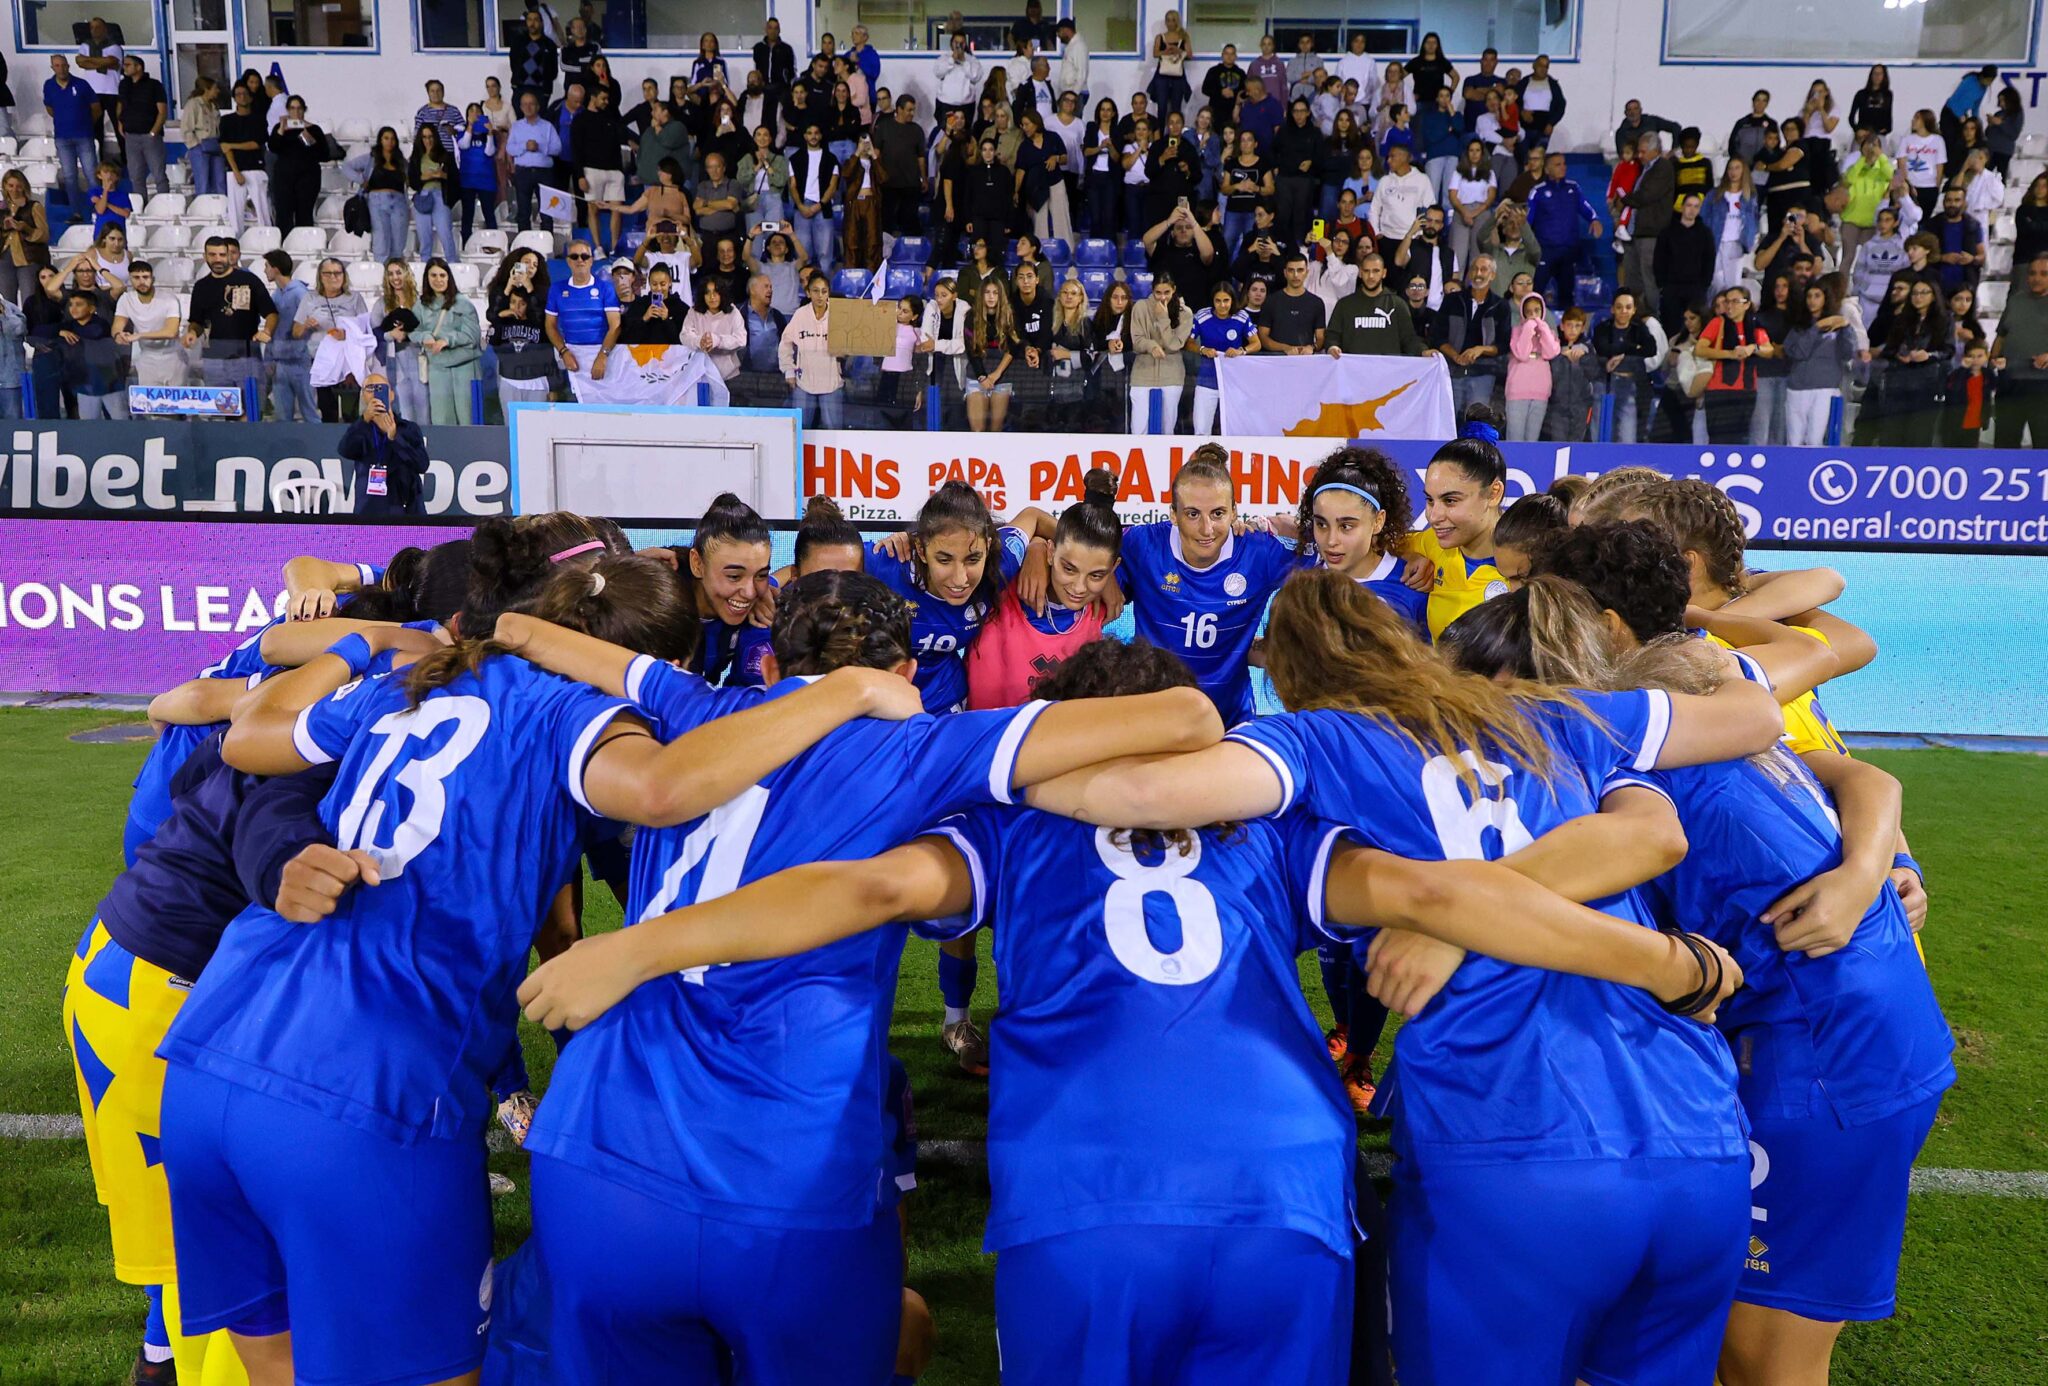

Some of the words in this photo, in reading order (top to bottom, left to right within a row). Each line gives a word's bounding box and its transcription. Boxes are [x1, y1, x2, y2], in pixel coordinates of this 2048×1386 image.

[1354, 316, 1387, 329] PUMA
[146, 387, 212, 402] ΚΑΡΠΑΣΙΑ
[0, 430, 178, 510] ibet
[803, 443, 901, 500] HNS
[928, 457, 1006, 489] PAPA
[1161, 447, 1320, 506] JHN
[1865, 465, 1968, 501] 7000
[849, 504, 902, 520] Pizza.
[1180, 611, 1219, 649] 16
[337, 695, 491, 881] 13
[1094, 825, 1223, 986] 8
